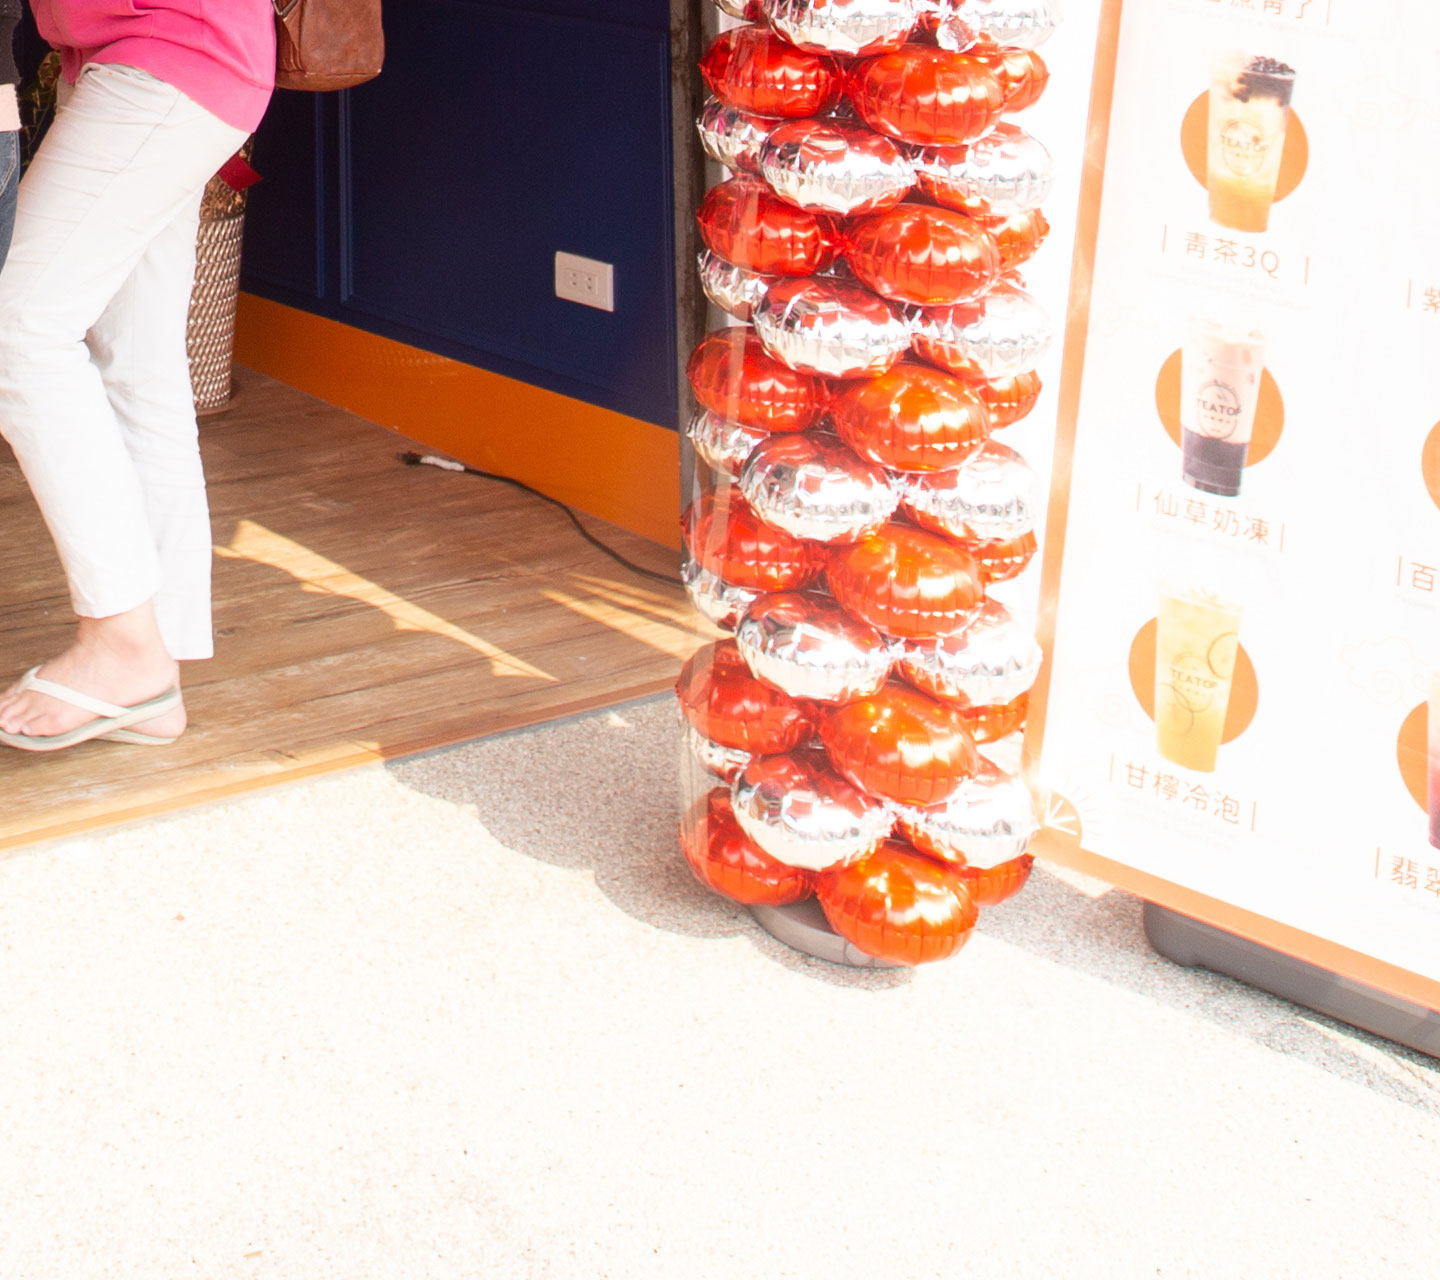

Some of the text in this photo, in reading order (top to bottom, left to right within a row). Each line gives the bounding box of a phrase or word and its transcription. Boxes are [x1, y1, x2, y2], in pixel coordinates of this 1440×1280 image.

[1183, 231, 1281, 280] 青茶3Q
[1153, 488, 1272, 546] 仙草奶凍
[1124, 760, 1241, 825] 甘檸冷泡
